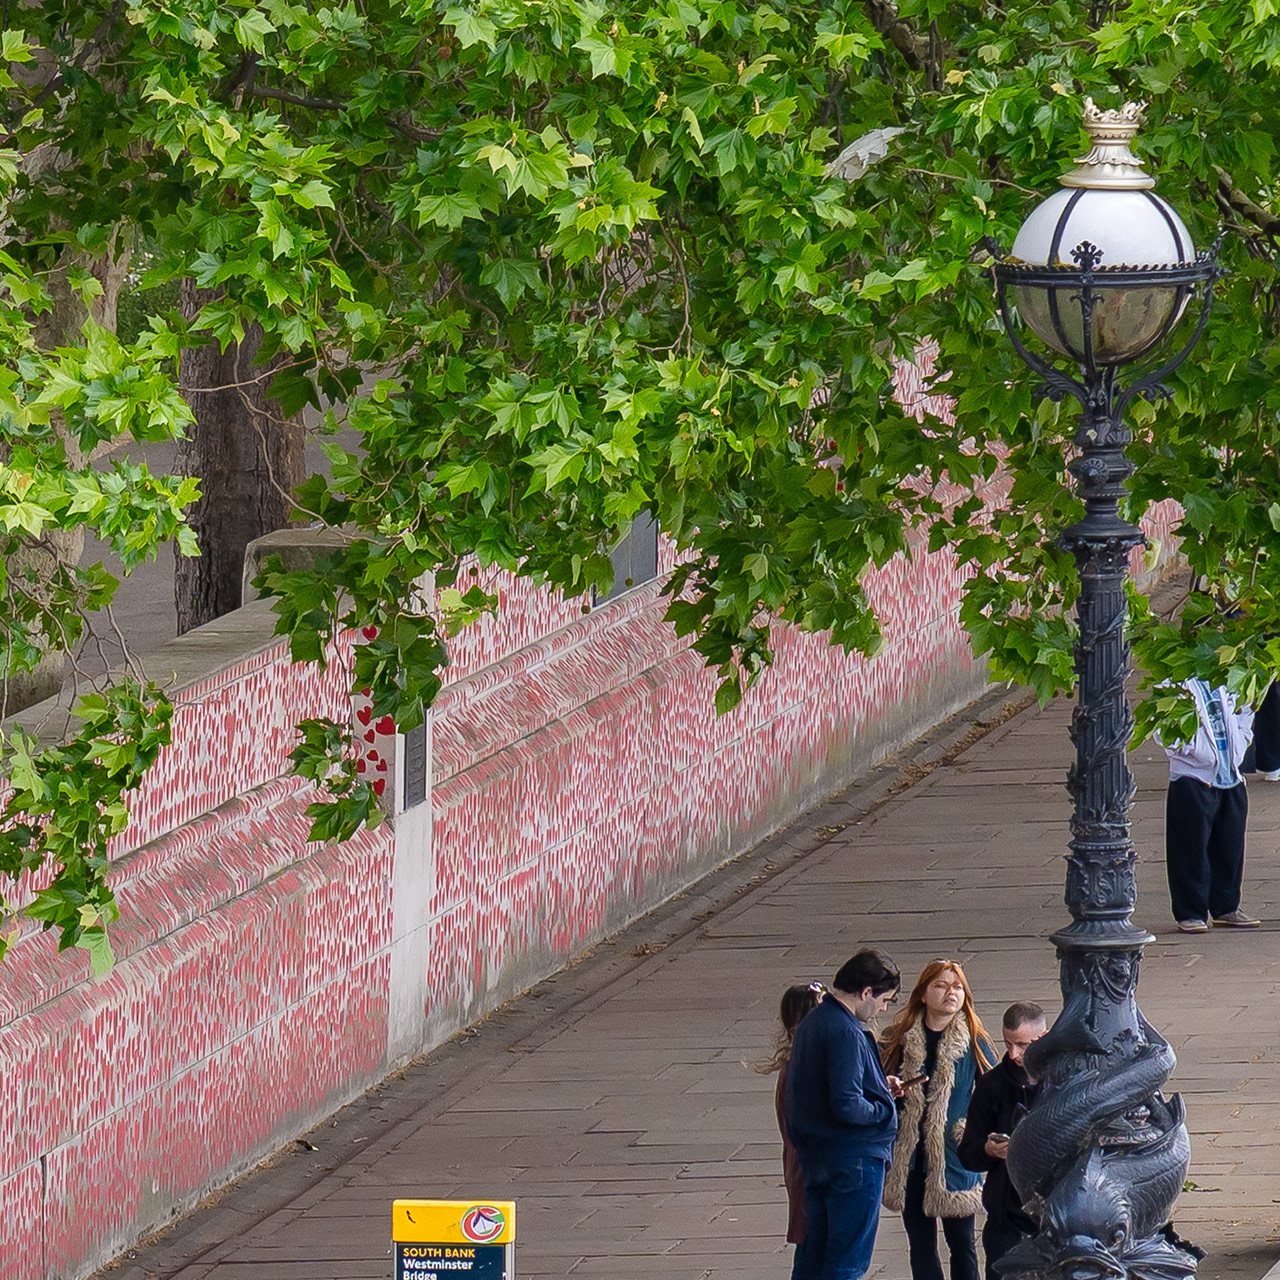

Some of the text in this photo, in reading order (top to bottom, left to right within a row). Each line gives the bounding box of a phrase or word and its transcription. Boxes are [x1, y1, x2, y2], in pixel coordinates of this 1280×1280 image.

[403, 1248, 476, 1259] SOUTH BANK
[403, 1258, 474, 1270] Westminster
